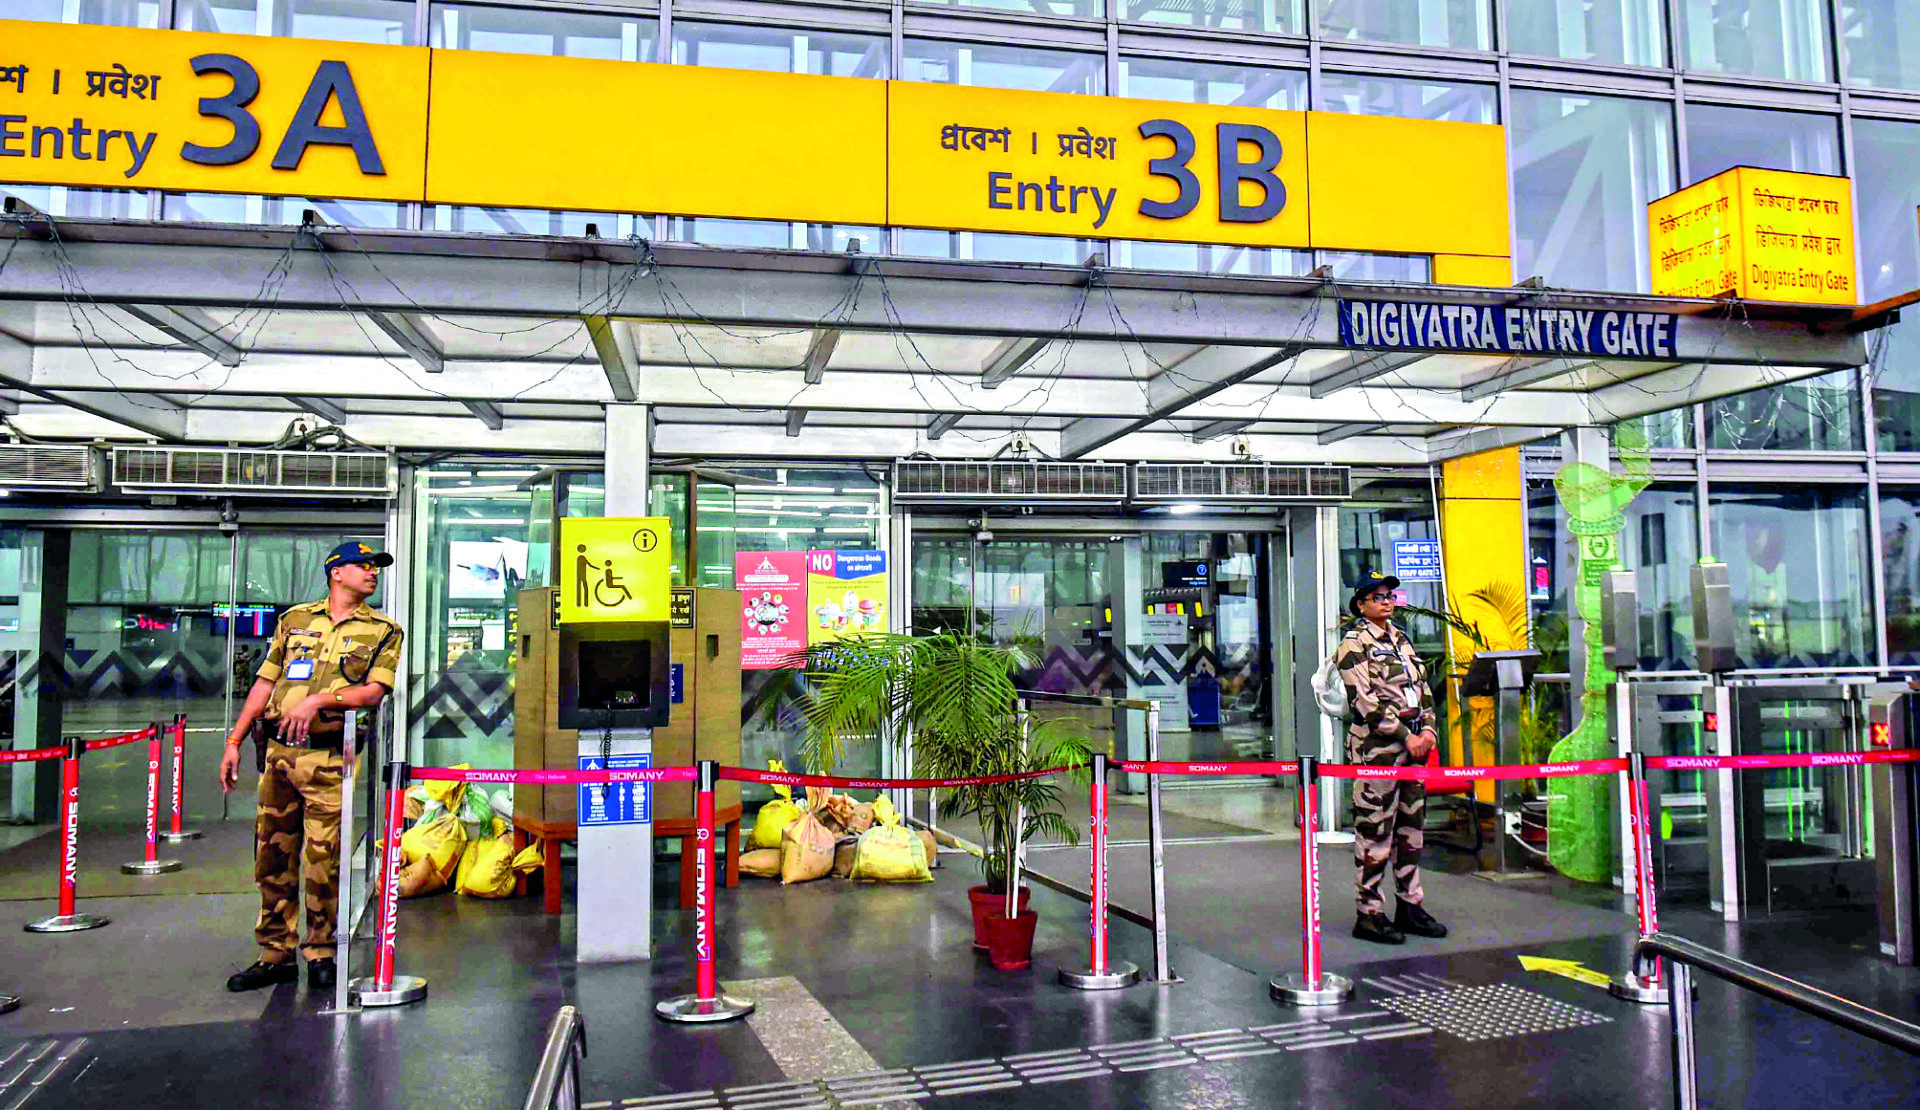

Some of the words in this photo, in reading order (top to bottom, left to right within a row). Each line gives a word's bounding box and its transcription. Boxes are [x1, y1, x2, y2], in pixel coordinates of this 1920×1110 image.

[86, 63, 161, 100] प्रवेश
[180, 53, 387, 176] 3A
[0, 115, 157, 178] Entry
[941, 123, 1011, 153] প্রবেশ
[1057, 126, 1117, 160] प्रवेश
[1138, 119, 1286, 223] 3B
[988, 171, 1117, 229] Entry
[1718, 270, 1738, 290] Gate
[1752, 264, 1797, 290] Digiyatra
[1799, 268, 1823, 293] Entry
[1826, 270, 1849, 291] Gate
[1351, 302, 1500, 349] DIGIYATRA
[1505, 308, 1595, 353] ENTRY
[1601, 312, 1670, 357] GATE
[812, 554, 833, 571] NO
[837, 555, 864, 563] Dangerous
[865, 554, 882, 562] Goods
[1399, 569, 1417, 577] STAFF
[1539, 765, 1579, 773] SOMANY
[1666, 758, 1720, 767] SOMANY
[1811, 754, 1863, 764] SOMANY
[465, 772, 517, 781] SOMANY
[609, 771, 664, 781] SOMANY
[760, 774, 801, 783] SOMANY
[147, 773, 155, 840] SOMANY
[65, 802, 78, 883] SOMANY
[387, 846, 401, 948] SOMANY
[697, 848, 705, 958] SOMANY
